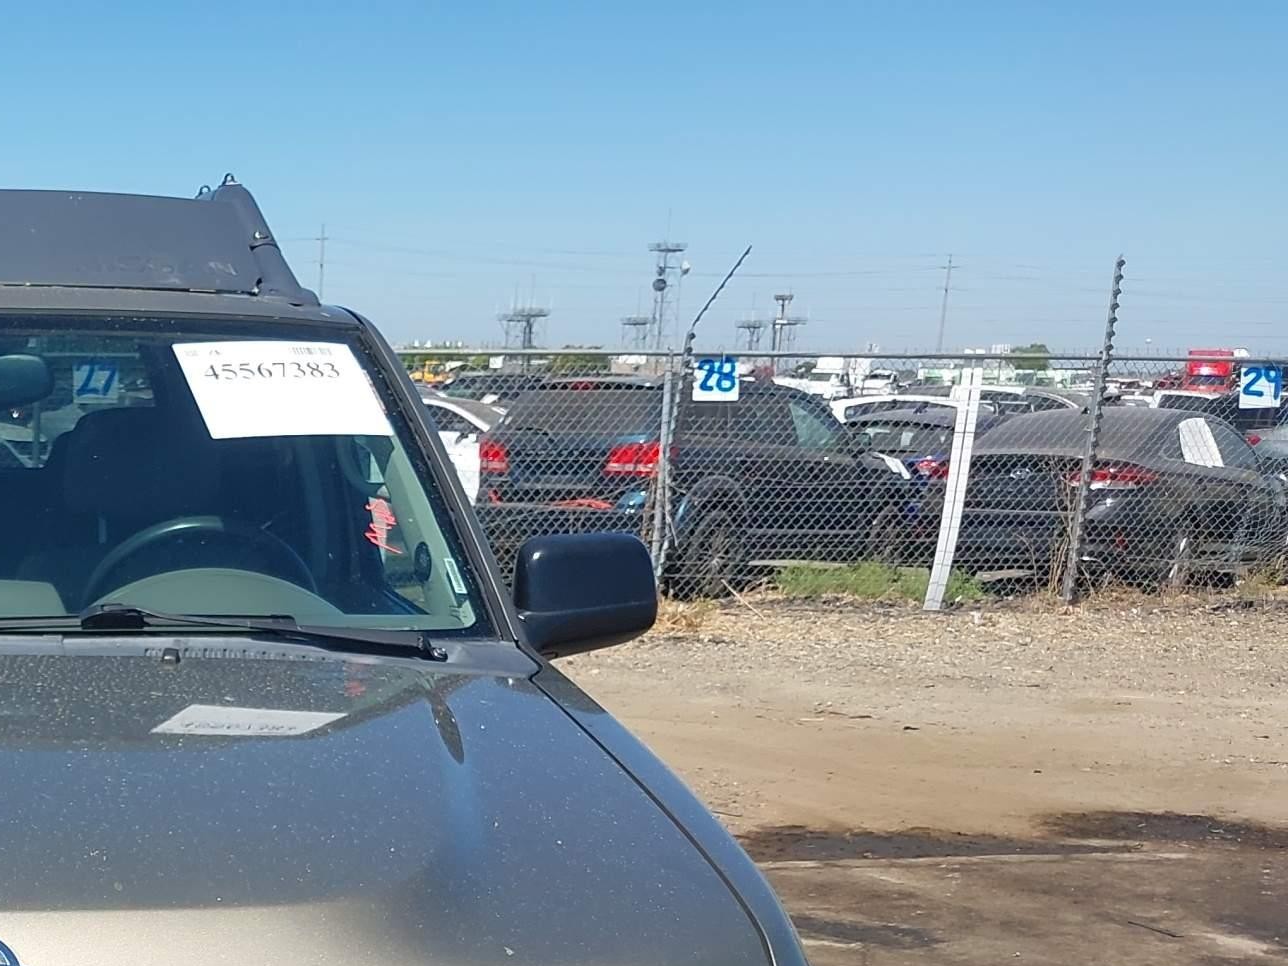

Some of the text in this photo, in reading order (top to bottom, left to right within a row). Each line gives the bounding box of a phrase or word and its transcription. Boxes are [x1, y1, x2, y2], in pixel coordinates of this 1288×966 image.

[76, 360, 117, 397] 27
[204, 362, 340, 380] 45567383
[697, 355, 736, 392] 28
[1242, 366, 1282, 400] 29
